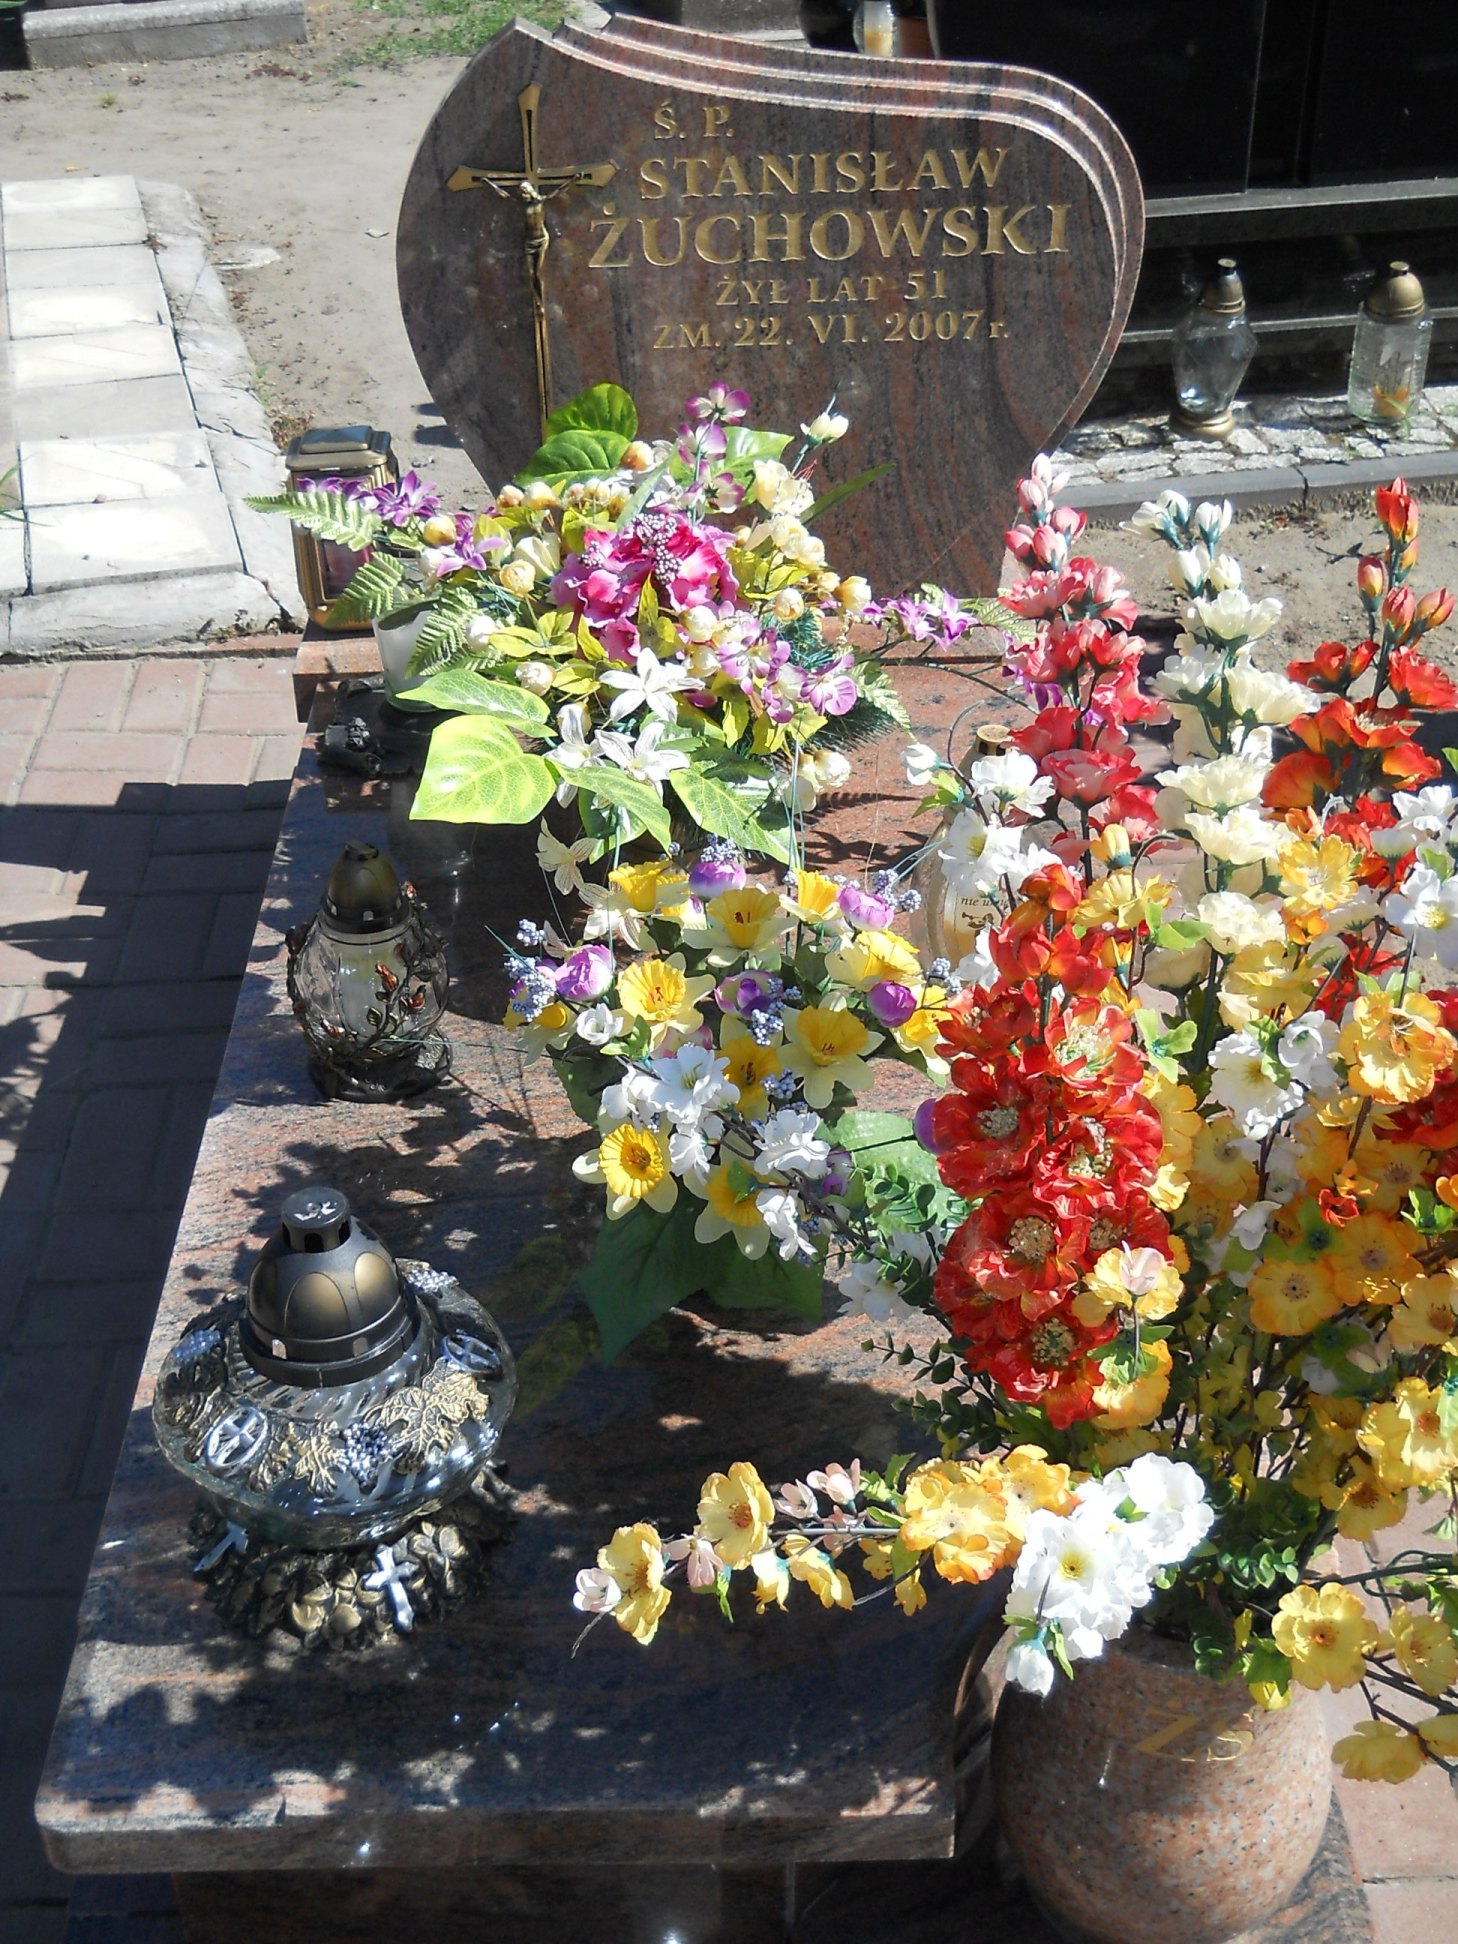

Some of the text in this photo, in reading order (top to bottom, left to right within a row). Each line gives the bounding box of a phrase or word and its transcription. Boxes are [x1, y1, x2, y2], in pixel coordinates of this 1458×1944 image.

[653, 101, 734, 139] Ś. P.
[639, 146, 1012, 200] STANISŁAW
[587, 203, 1072, 268] ŻUCHOWSKI
[715, 269, 948, 306] ŻYŁ LAT 51
[652, 322, 721, 349] ZM.
[734, 316, 793, 347] 22.
[808, 313, 868, 344] VI.
